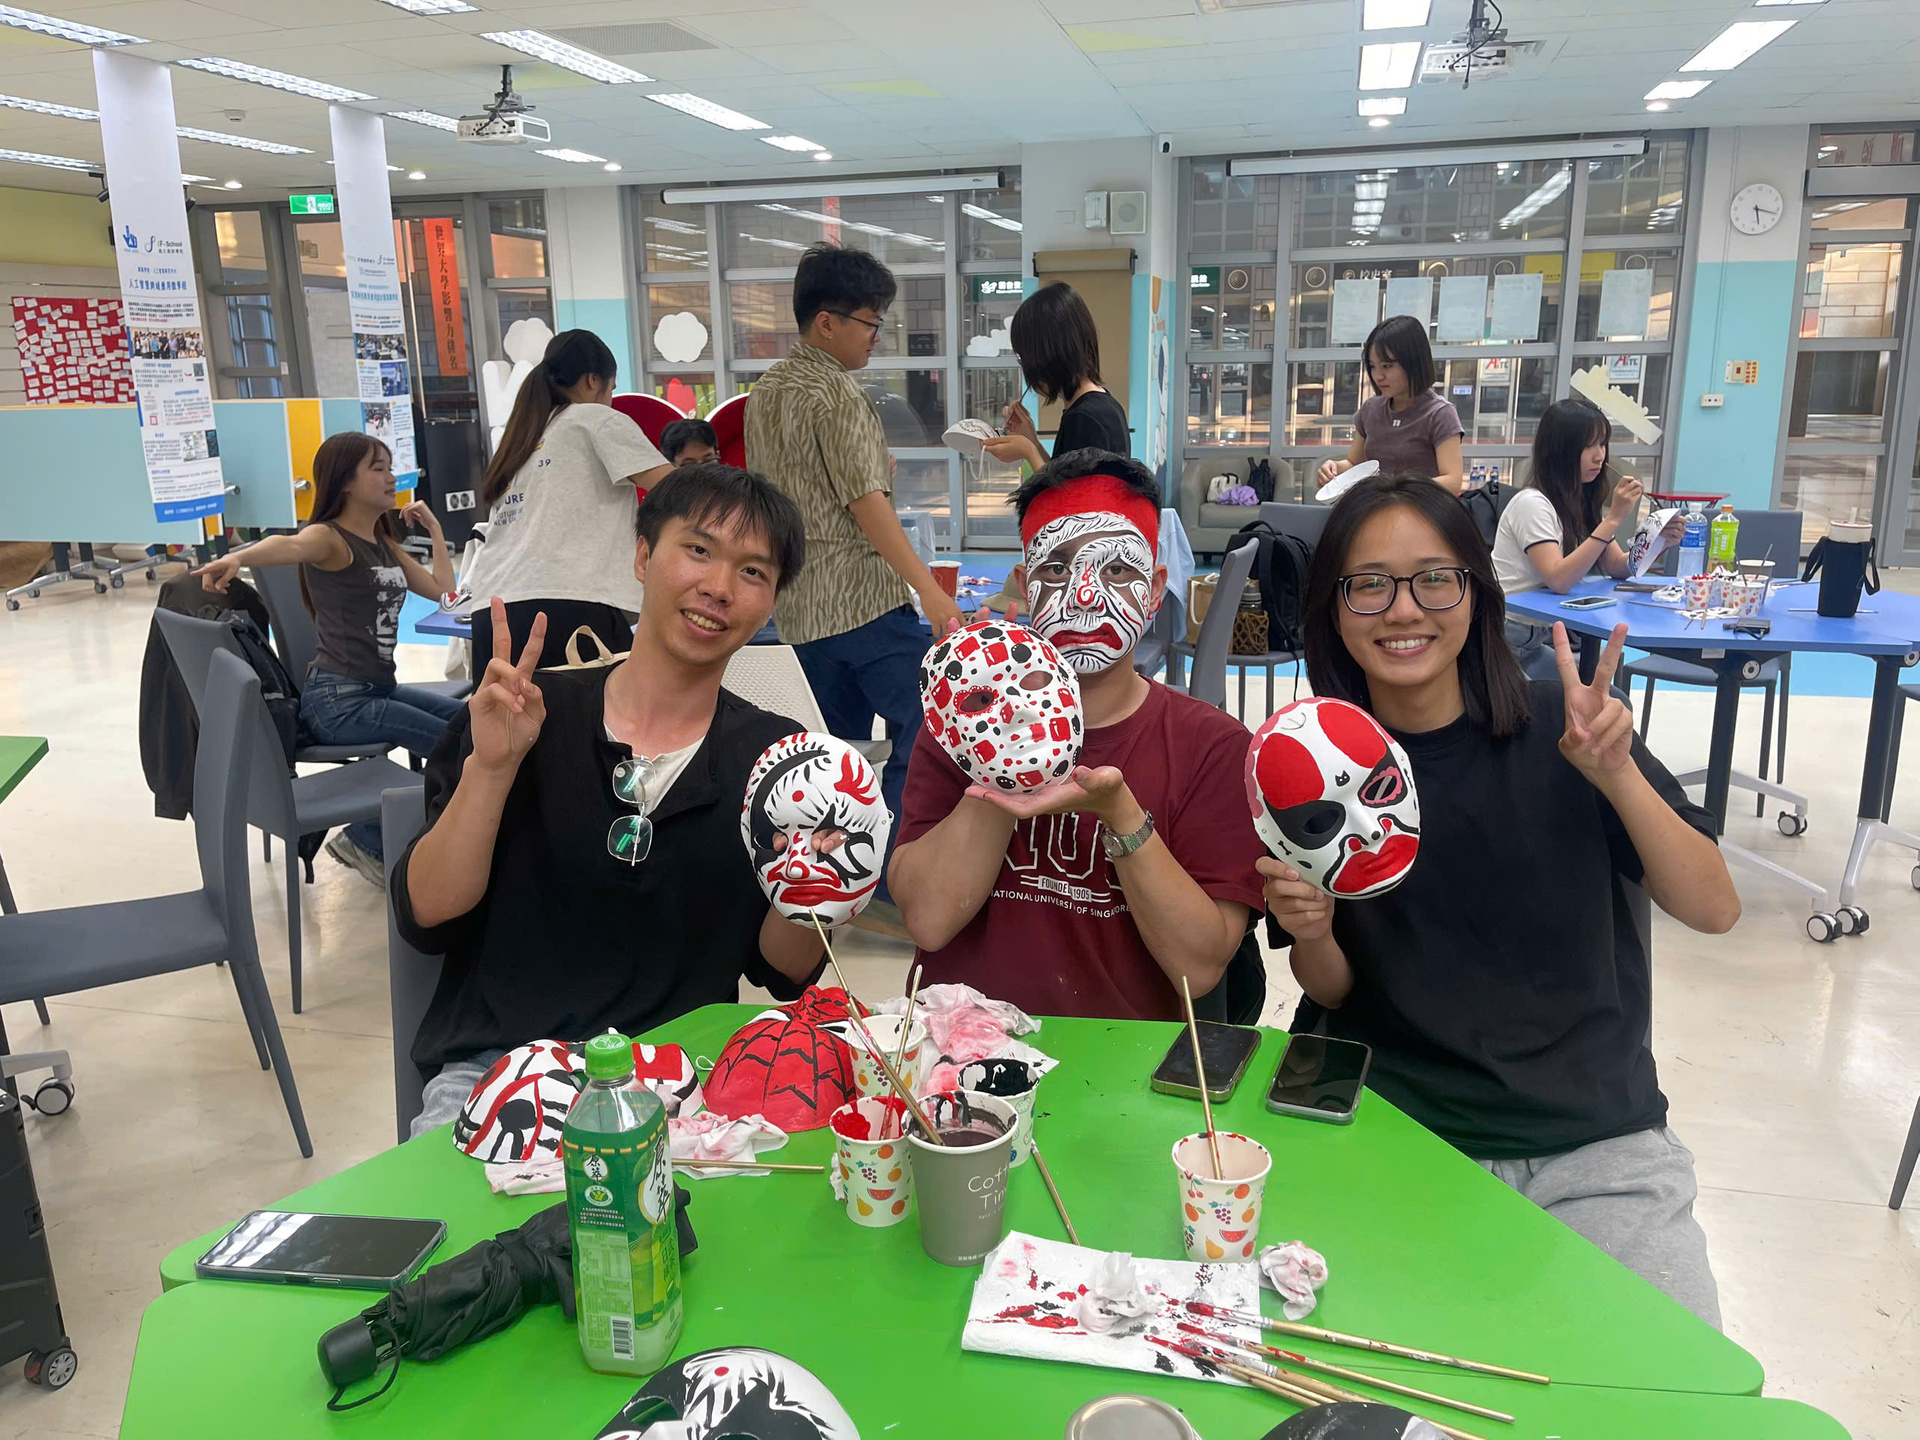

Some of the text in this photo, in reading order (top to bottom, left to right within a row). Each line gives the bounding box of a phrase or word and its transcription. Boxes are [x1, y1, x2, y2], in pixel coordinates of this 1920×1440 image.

[538, 458, 552, 468] 39
[1041, 877, 1090, 900] FOUNDE 1905
[991, 889, 1033, 902] ATIONAL
[1034, 895, 1075, 910] UNIVERSI
[1076, 906, 1088, 914] OF
